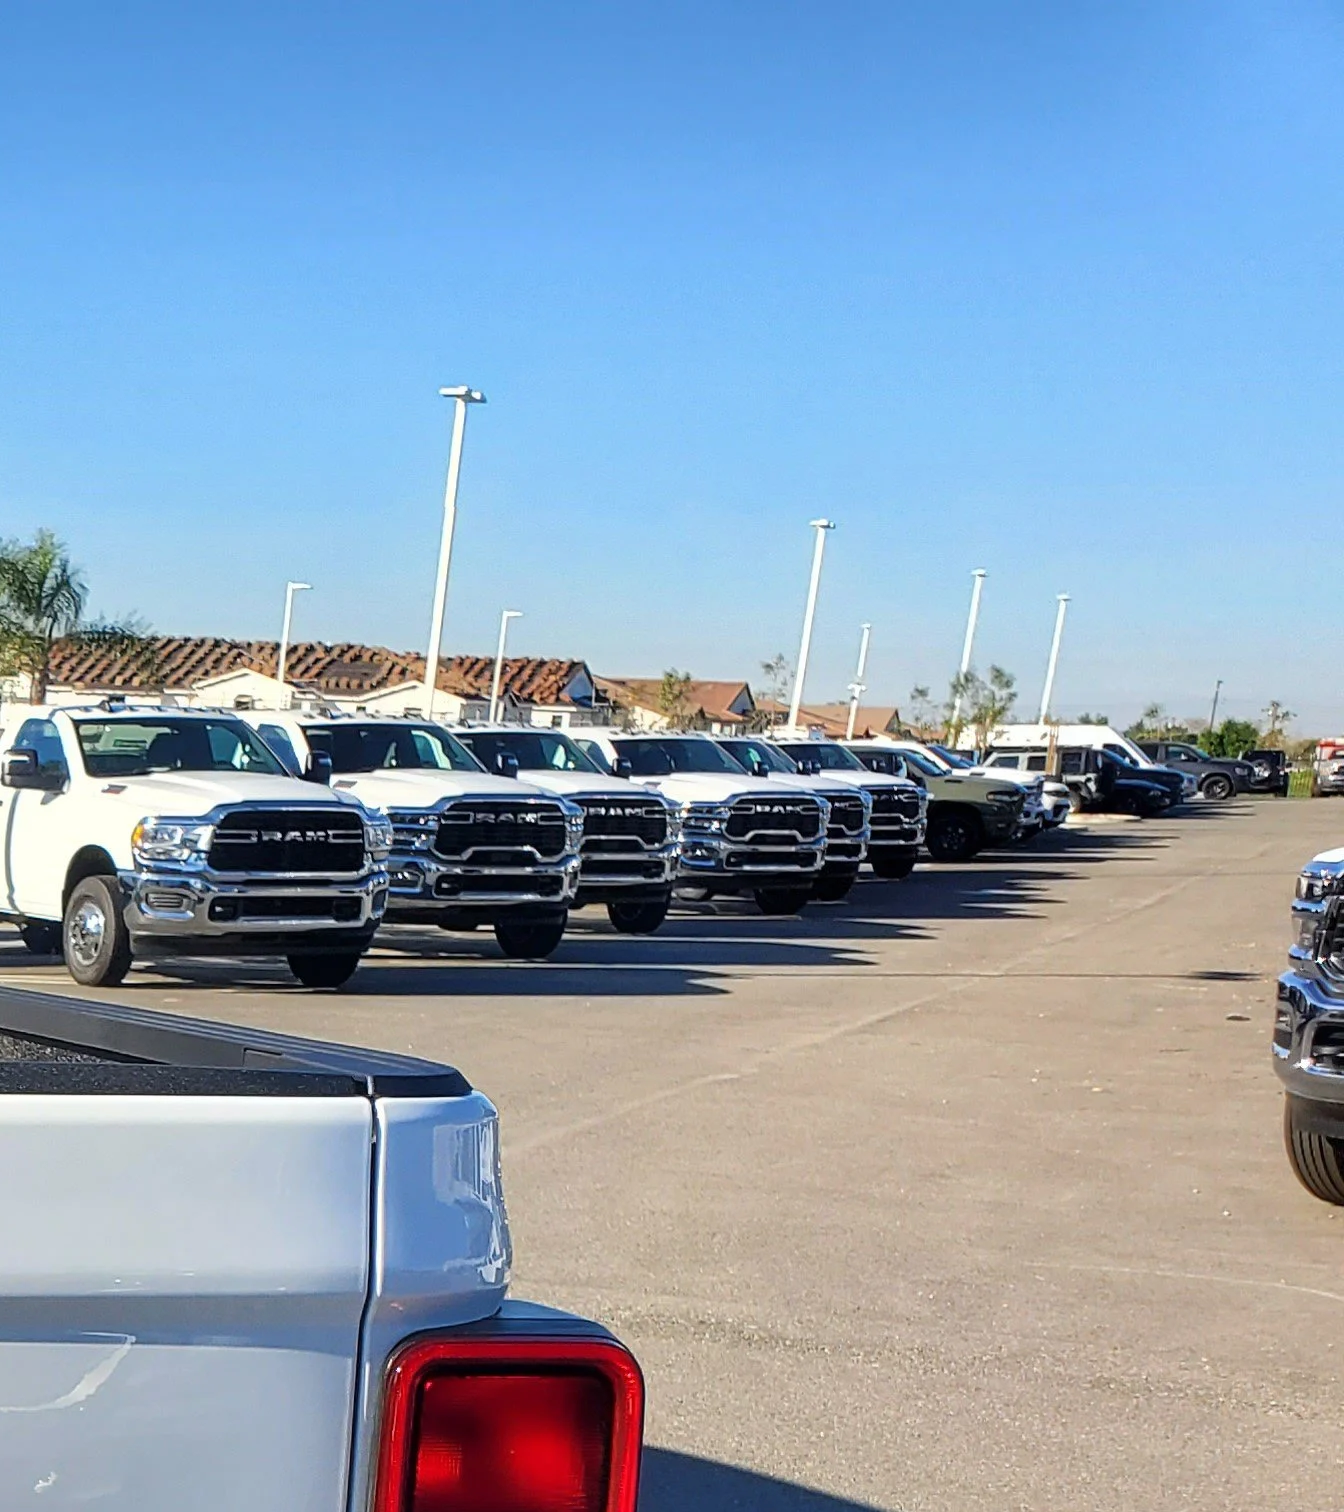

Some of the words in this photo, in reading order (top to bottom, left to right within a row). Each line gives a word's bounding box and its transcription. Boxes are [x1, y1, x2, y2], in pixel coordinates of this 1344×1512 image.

[475, 812, 538, 824] RAM
[587, 807, 642, 817] RAM
[261, 830, 327, 842] RAM
